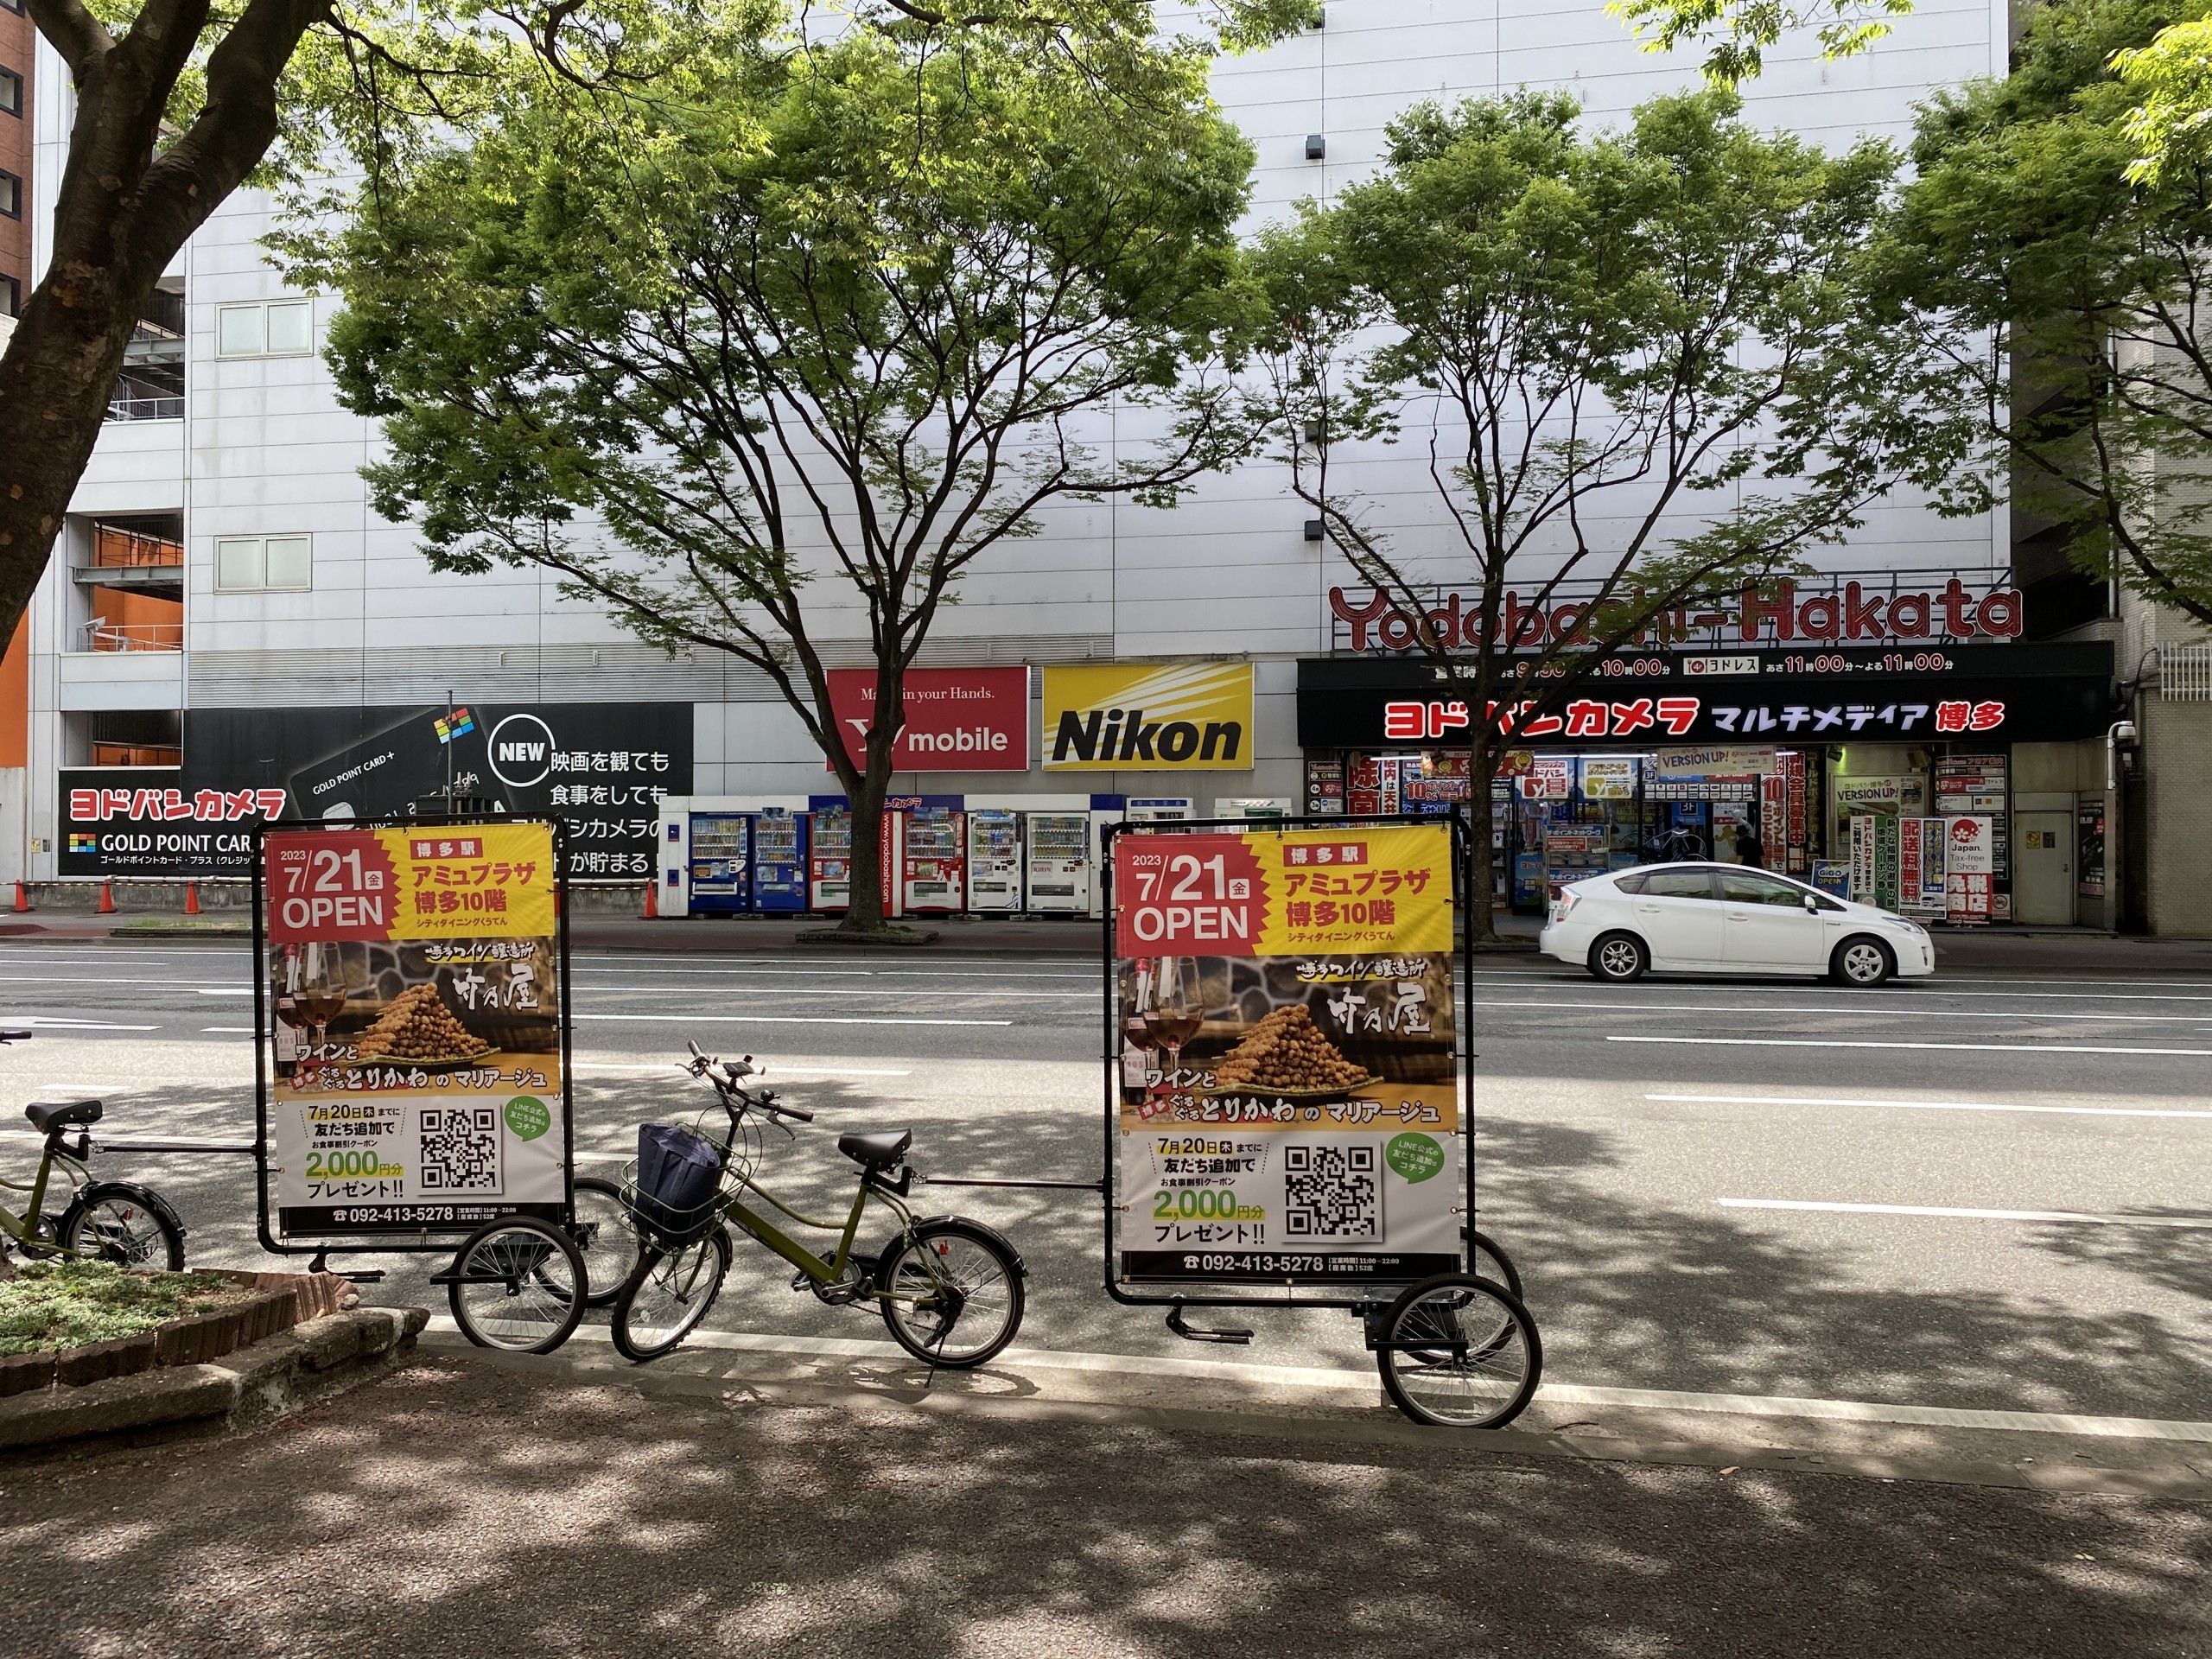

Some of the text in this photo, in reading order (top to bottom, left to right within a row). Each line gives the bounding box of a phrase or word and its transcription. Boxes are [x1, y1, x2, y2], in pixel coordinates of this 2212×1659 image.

[1709, 659, 1756, 672] ヨドレス
[917, 690, 947, 703] your
[950, 687, 995, 700] Hands.
[1384, 697, 2005, 739] ヨドバシカメラ マルチメディア 博多
[908, 727, 1008, 753] mobile
[1052, 708, 1243, 761] Nikon
[499, 741, 545, 761] NEW
[1662, 751, 1710, 768] VERSION
[1711, 750, 1729, 762] UP!
[550, 751, 669, 772] 映画を観ても
[313, 778, 337, 796] GOLD
[337, 766, 362, 785] POINT
[1347, 755, 1381, 814] 除菌
[70, 788, 287, 821] ヨドバシカメラ
[550, 785, 668, 805] 食事をしても
[1788, 751, 1807, 845] 新規会員募集中
[1837, 788, 1899, 801] VERSION UP!
[101, 834, 151, 852] GOLD
[156, 834, 212, 852] POINT
[416, 841, 475, 857] 博多駅
[1951, 844, 1982, 853] Japan.
[280, 850, 306, 861] 2023
[1132, 855, 1161, 866] 2023
[1291, 846, 1359, 864] 博多駅
[1853, 822, 1862, 891] ご利用いただけます
[1877, 828, 1886, 889] 地域クーポン券
[1901, 819, 1921, 902] 配送料無料
[283, 849, 362, 893] 7/21
[411, 861, 537, 887] アミュプラザ
[1955, 862, 1979, 871] Shop
[1135, 854, 1225, 901] 7/21
[1284, 868, 1431, 897] アミュプラザ
[1947, 874, 1988, 893] 免税
[415, 888, 507, 914] 博多10階
[1947, 893, 1988, 912] 商店
[283, 895, 383, 929] OPEN
[1286, 901, 1395, 928] 博多10階
[416, 917, 508, 928] シティダイニングくうてん
[1134, 906, 1248, 942] OPEN
[1287, 931, 1395, 944] シティダイニングくうてん
[452, 963, 538, 1011] 竹乃屋
[1326, 982, 1431, 1035] 竹乃屋
[295, 1042, 359, 1062] ワインと
[346, 1067, 429, 1090] とりかわ
[435, 1072, 450, 1088] の
[454, 1068, 547, 1089] マリアージュ
[1145, 1068, 1217, 1089] ワインと
[510, 1110, 545, 1126] 友だち追加は
[514, 1103, 545, 1116] LINE公式の
[1141, 1100, 1166, 1116] 博多
[1201, 1096, 1295, 1123] とりかわ
[1304, 1104, 1320, 1121] の
[1325, 1101, 1440, 1123] マリアージュ
[315, 1122, 395, 1136] 友だち追加で
[515, 1122, 537, 1133] コチラ
[312, 1140, 378, 1148] お食事割引クーポン
[1398, 1141, 1439, 1156] LINE公式の
[306, 1150, 403, 1180] 2,000円分
[1164, 1158, 1255, 1173] 友だち追加で
[1393, 1149, 1437, 1166] 友だち追加は
[1400, 1161, 1426, 1174] コチラ
[308, 1179, 404, 1199] プレゼント!!
[1160, 1178, 1236, 1187] お食事割引クーポン
[349, 1207, 454, 1222] 092-413-5278
[1154, 1189, 1264, 1222] 2,000円分
[1155, 1223, 1265, 1244] プレゼント!!
[1203, 1255, 1324, 1272] 092-413-5278
